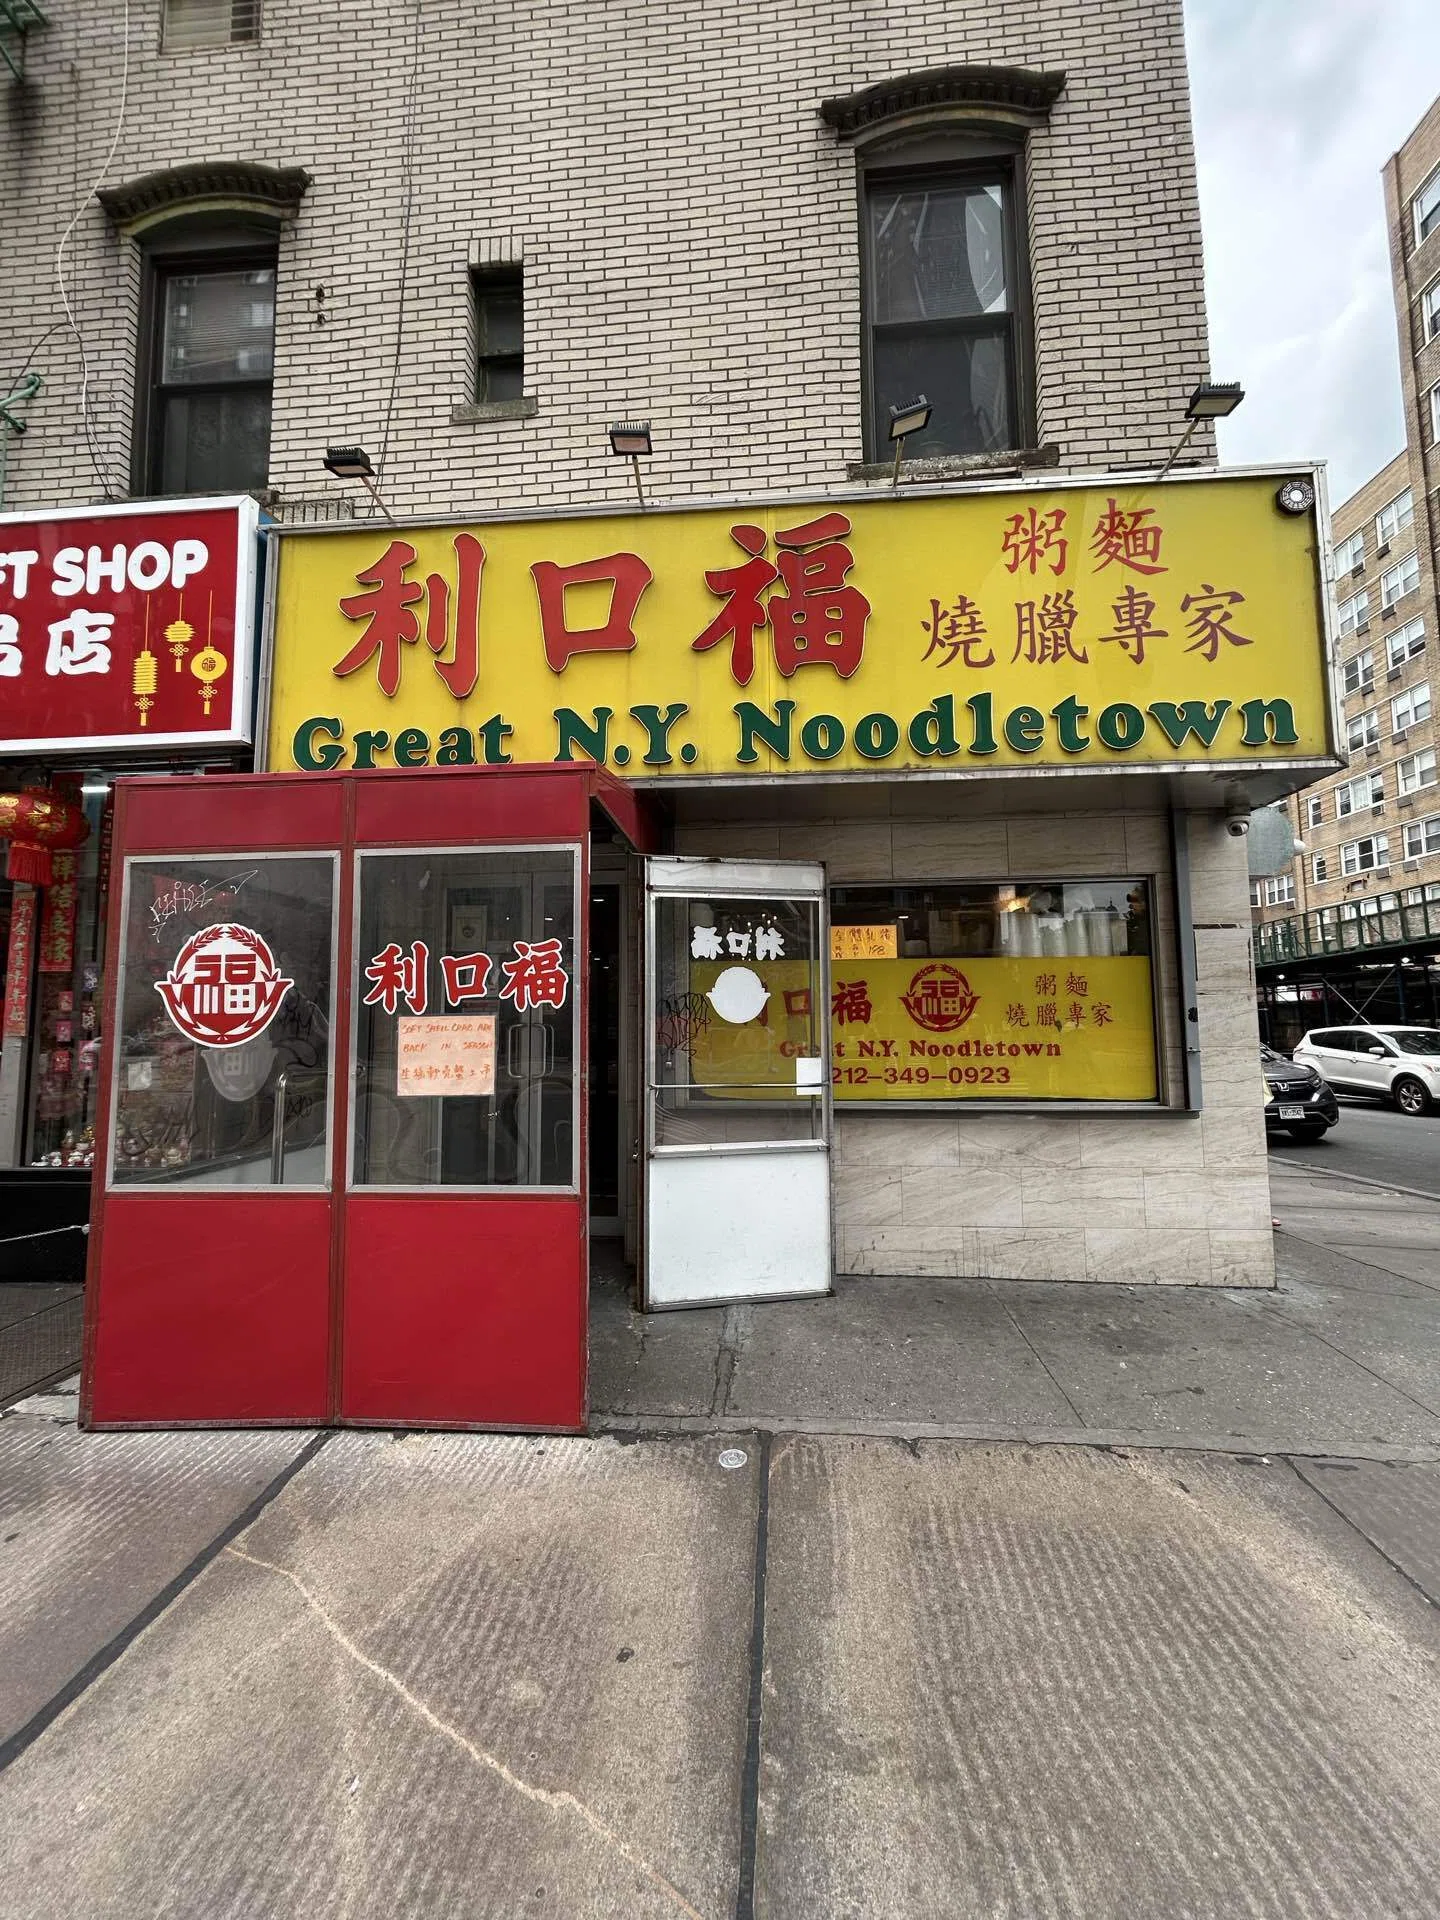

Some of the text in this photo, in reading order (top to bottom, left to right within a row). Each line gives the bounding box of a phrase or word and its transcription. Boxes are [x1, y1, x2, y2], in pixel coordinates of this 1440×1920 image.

[51, 538, 209, 597] SHOP
[1001, 497, 1169, 576] 粥麵
[331, 511, 872, 698] 利口福
[920, 583, 1254, 669] 燒臘專家
[292, 691, 1299, 771] Great N.Y. Noodletown
[363, 938, 568, 1015] 利口福
[1034, 970, 1089, 998] 粥麵
[832, 1066, 1011, 1085] 212-349-0923
[857, 1040, 899, 1057] N.Y.
[909, 1039, 1062, 1058] Noodletown
